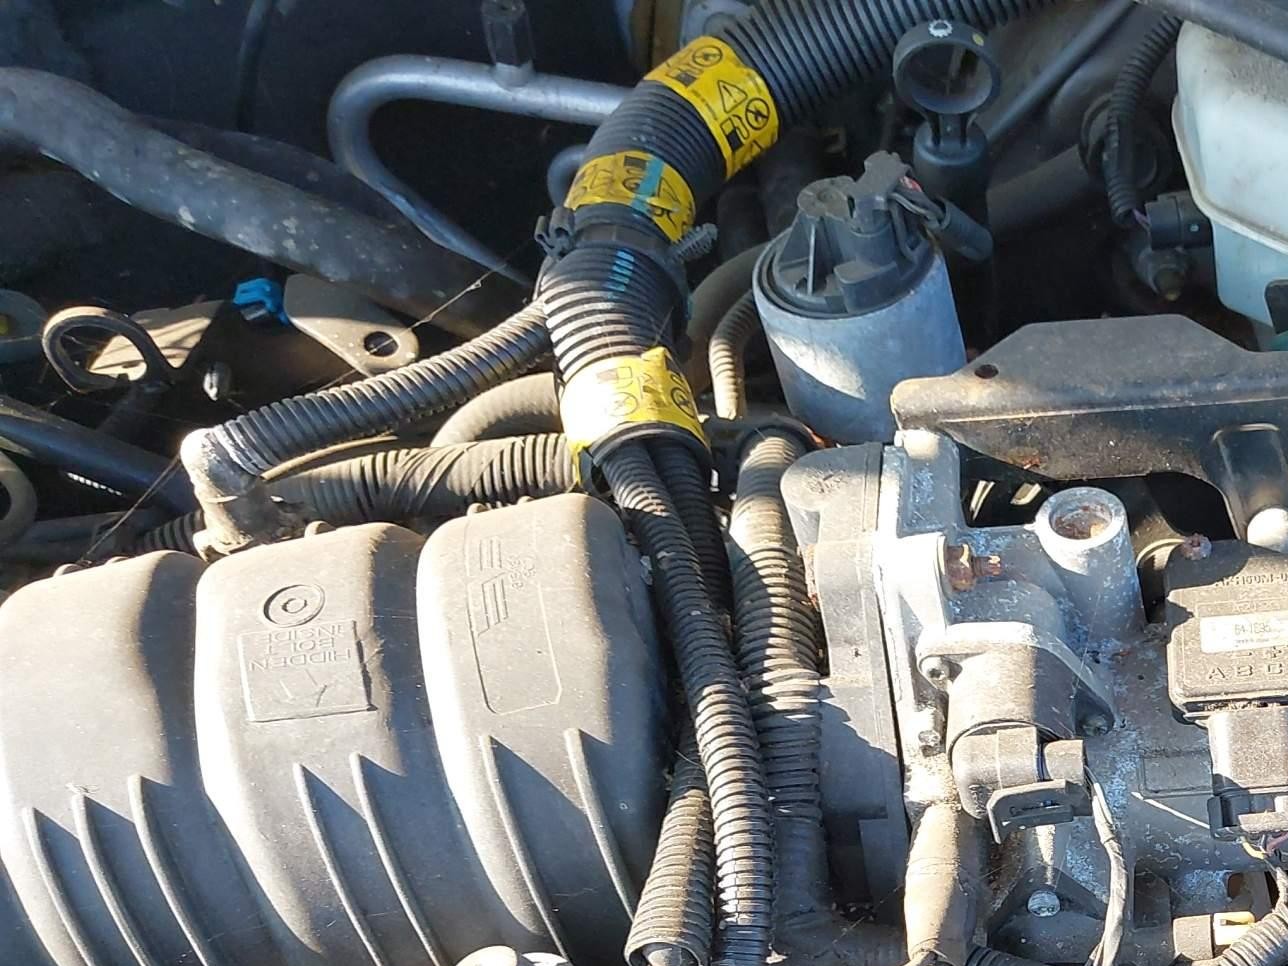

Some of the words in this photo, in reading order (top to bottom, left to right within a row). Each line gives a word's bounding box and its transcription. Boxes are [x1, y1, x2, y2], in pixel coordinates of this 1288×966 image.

[267, 636, 335, 656] BOLT
[249, 648, 351, 671] HIDDEN
[1208, 668, 1226, 681] A
[1235, 664, 1254, 677] B
